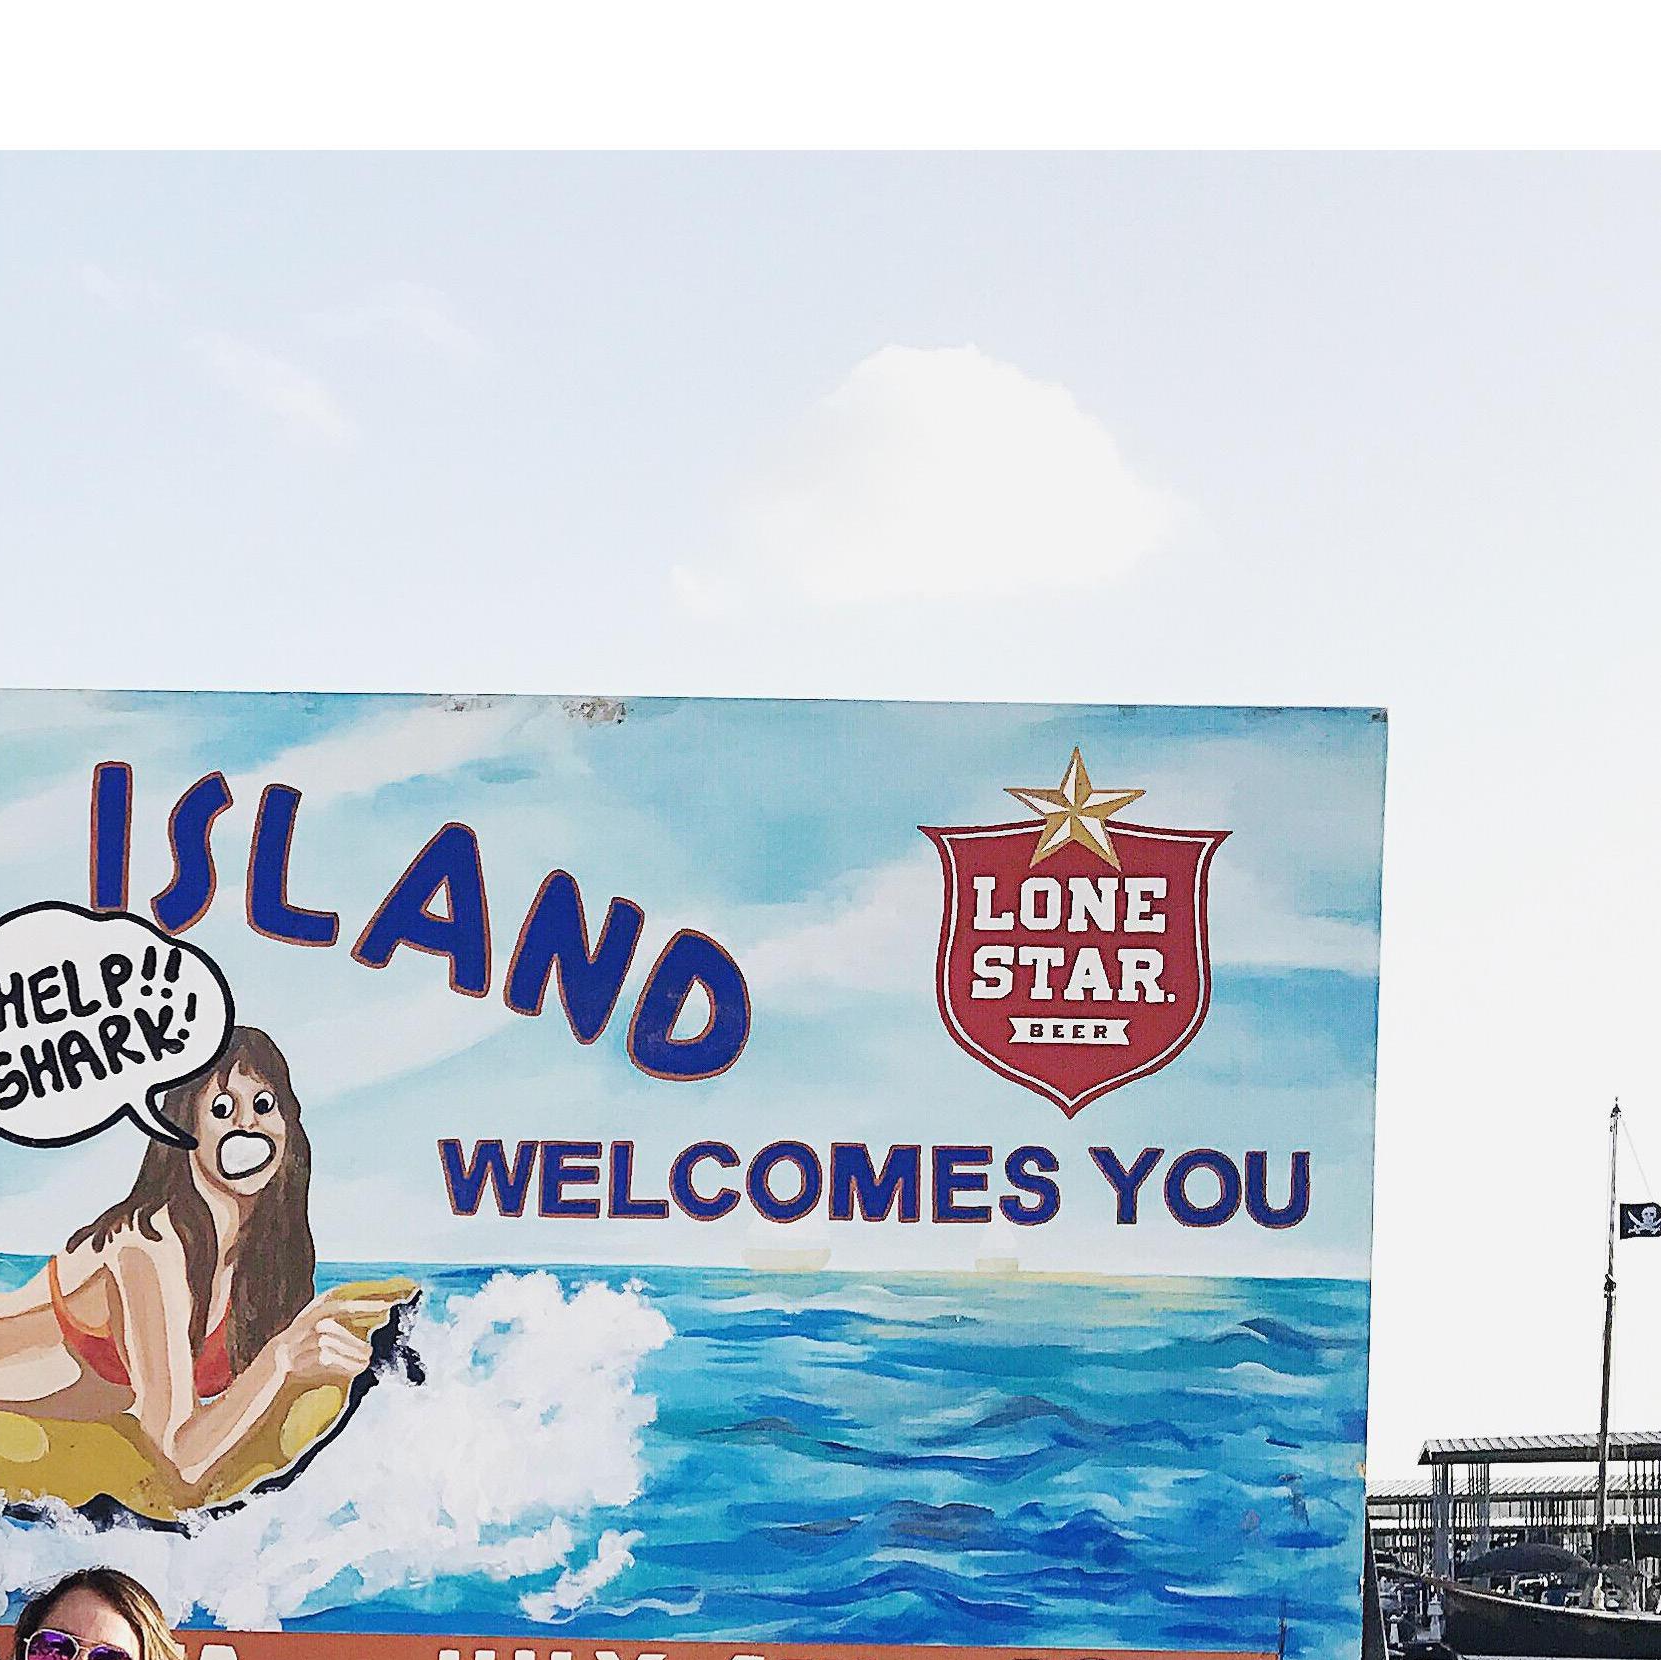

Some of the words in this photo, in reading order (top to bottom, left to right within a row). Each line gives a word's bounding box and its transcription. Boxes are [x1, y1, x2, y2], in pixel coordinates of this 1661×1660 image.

[89, 760, 752, 1082] ISLAND
[972, 876, 1168, 933] LONE
[1029, 1023, 1108, 1039] BEER
[437, 1139, 1061, 1226] WELCOMES
[1088, 1146, 1311, 1229] YOU
